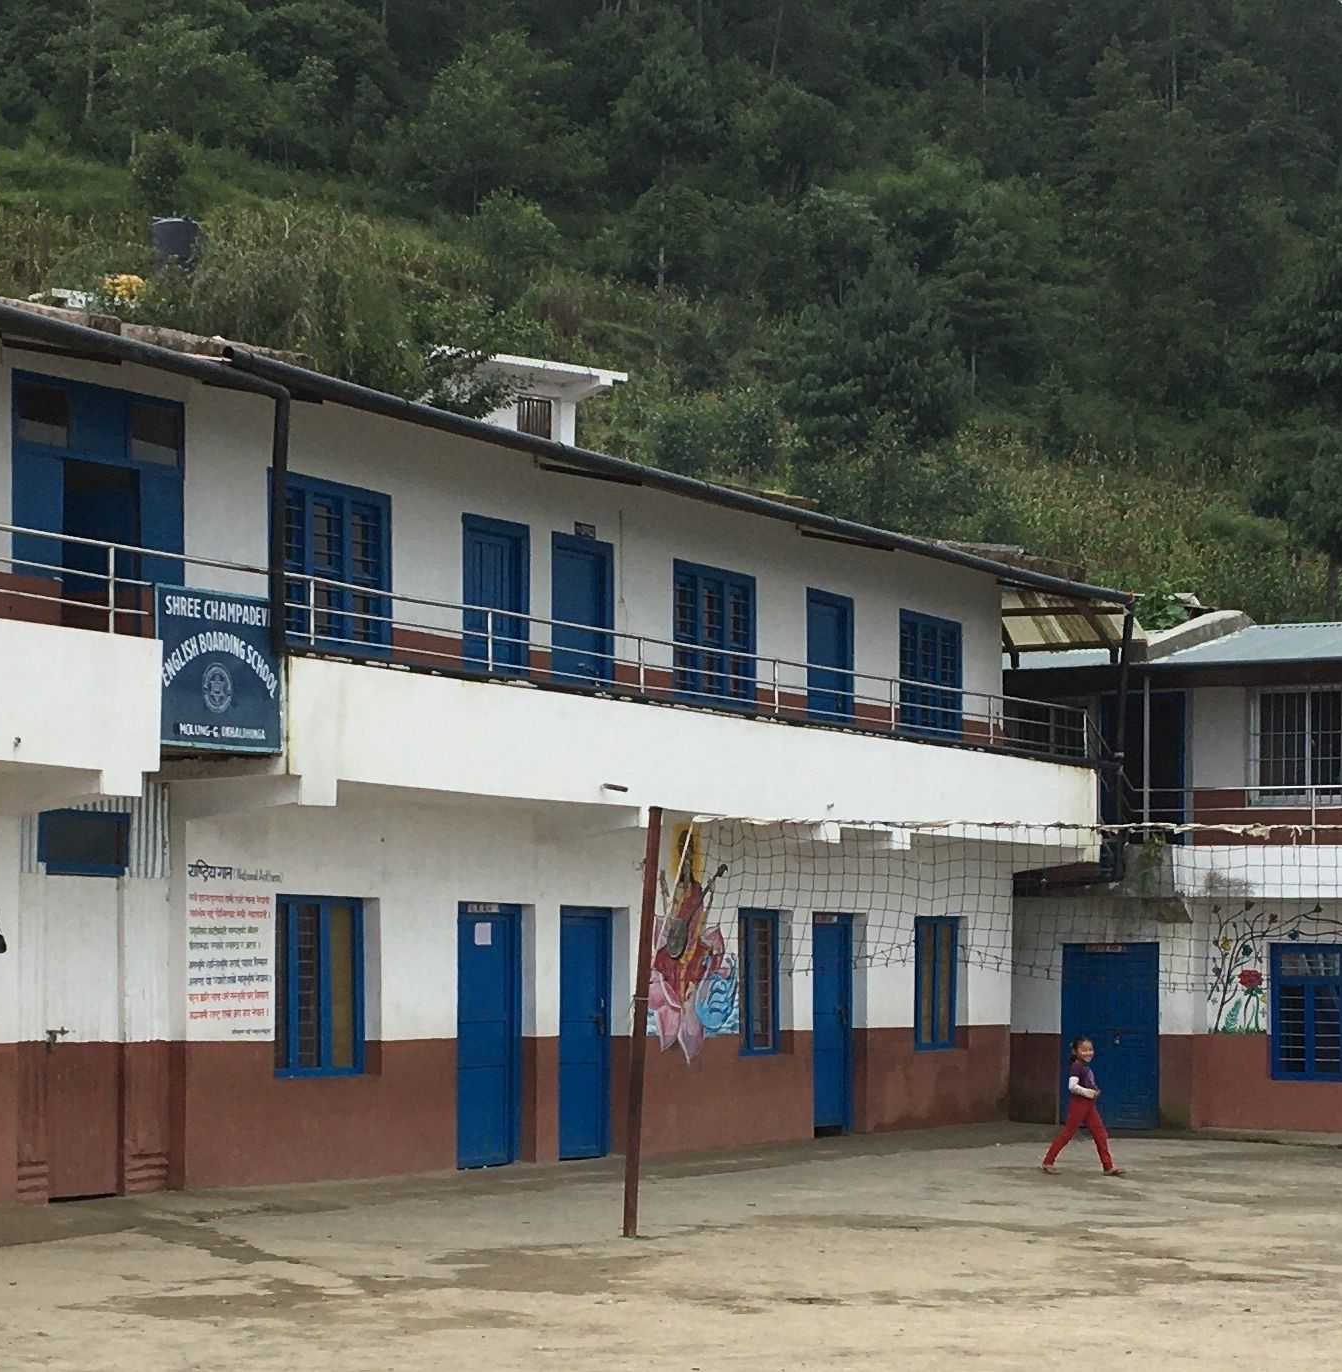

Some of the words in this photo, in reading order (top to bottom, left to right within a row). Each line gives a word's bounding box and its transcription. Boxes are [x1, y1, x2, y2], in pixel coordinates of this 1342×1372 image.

[165, 595, 201, 619] SHREE
[203, 600, 271, 628] CHAMPADEVI
[161, 635, 200, 688] ENGLISH
[198, 630, 246, 660] BOARDING
[245, 644, 278, 699] SCHOOL
